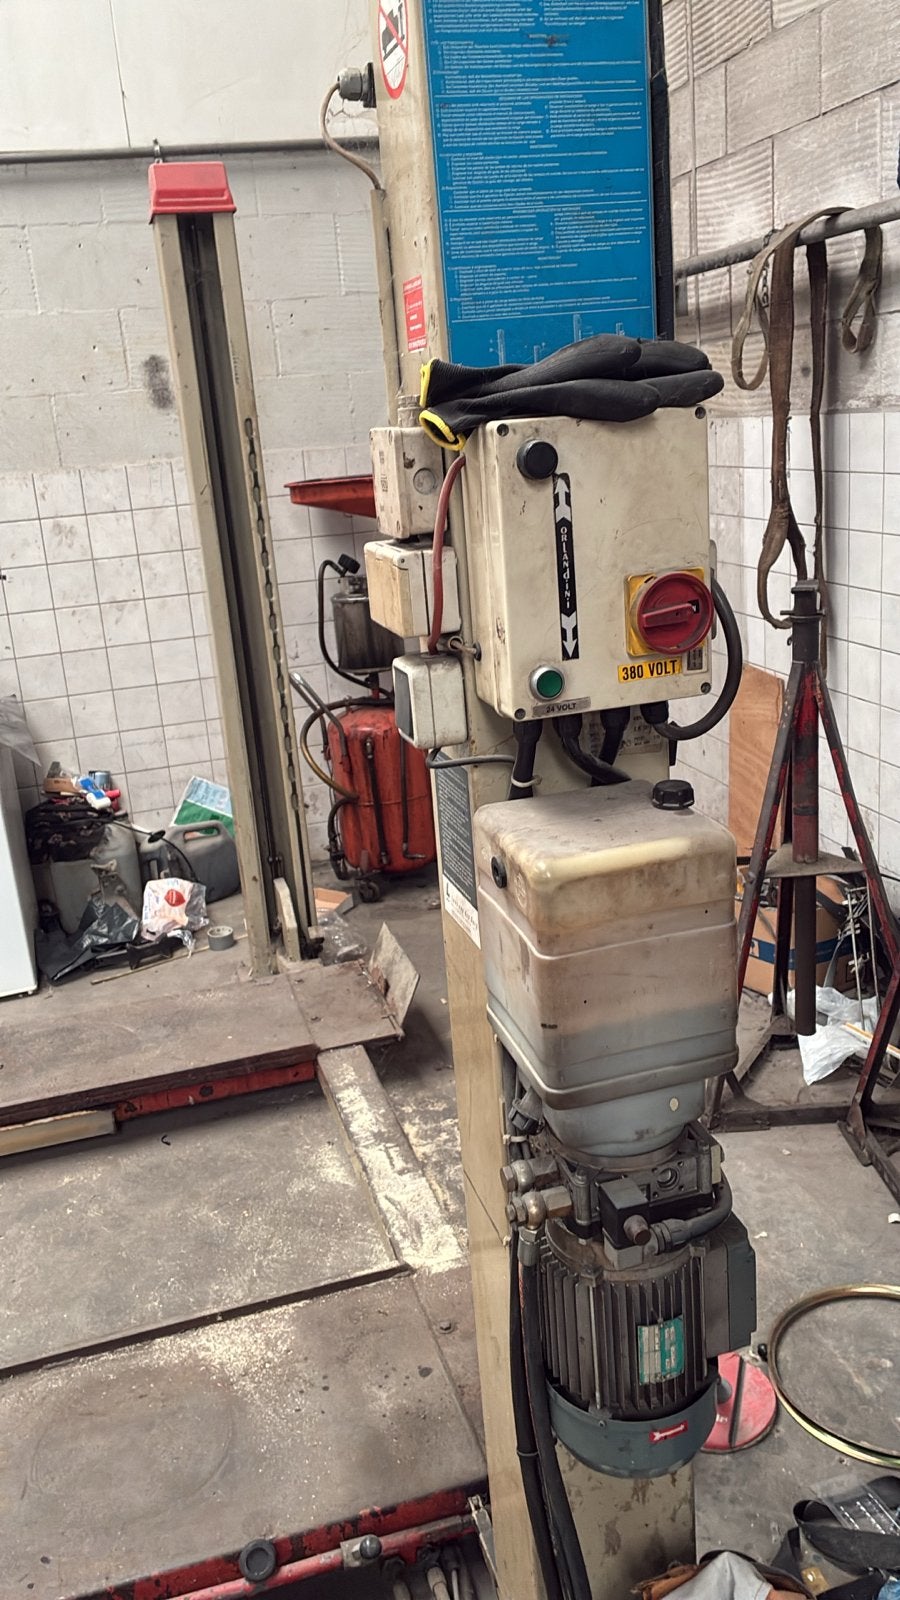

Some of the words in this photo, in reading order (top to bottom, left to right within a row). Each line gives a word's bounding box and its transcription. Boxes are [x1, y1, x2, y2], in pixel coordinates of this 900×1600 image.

[622, 665, 644, 681] 380
[648, 660, 678, 677] VOLT
[546, 705, 555, 713] 24
[557, 703, 577, 712] VOLT
